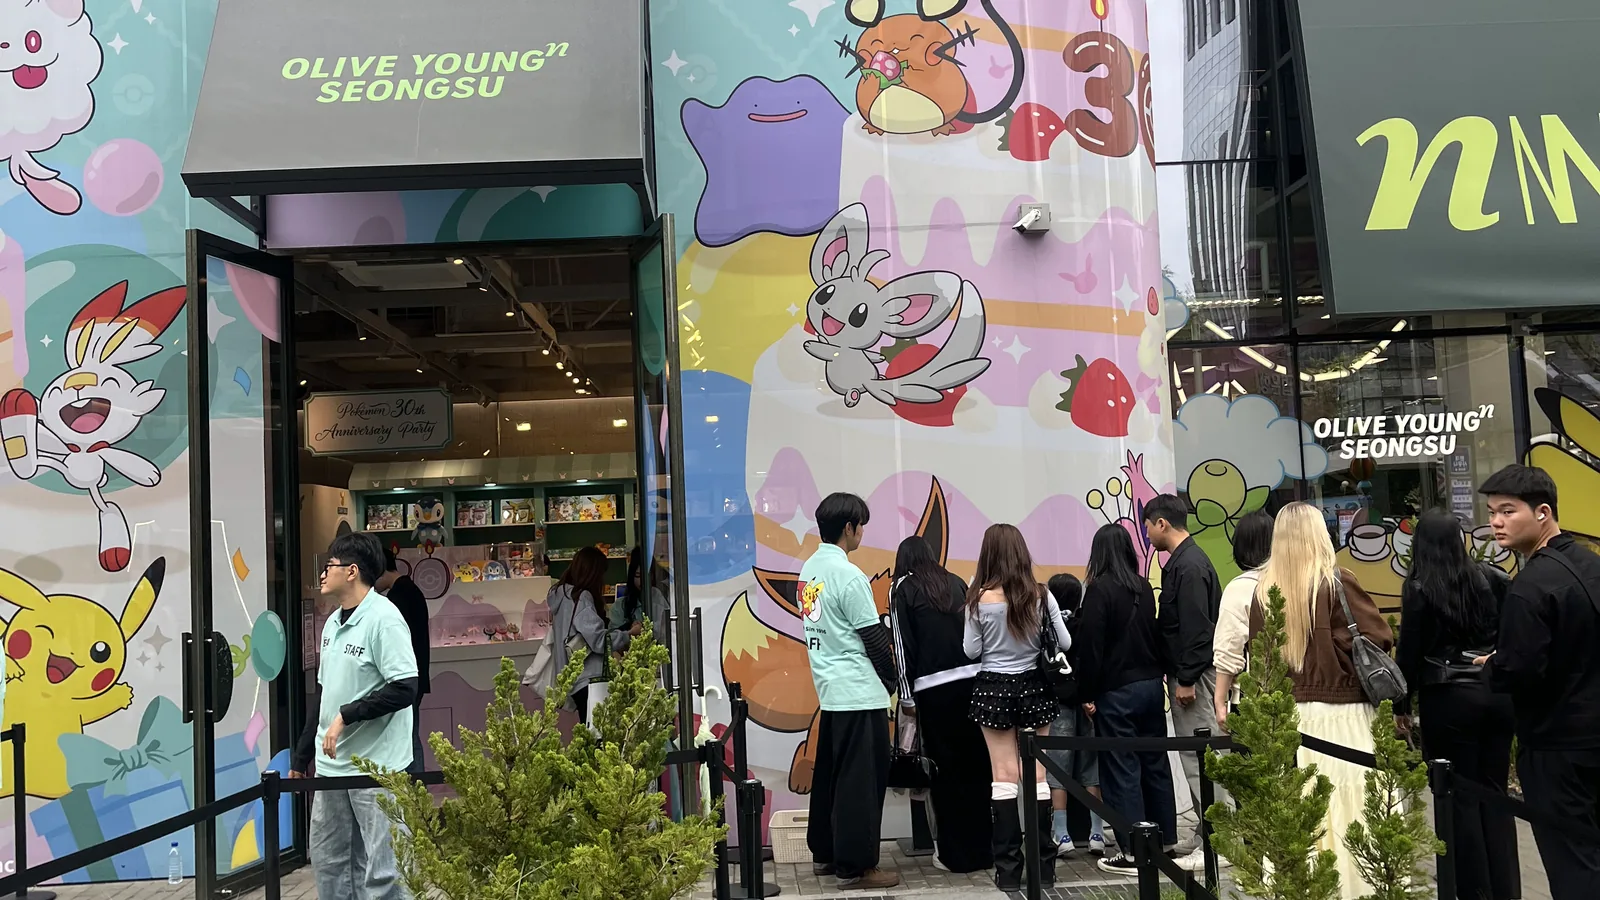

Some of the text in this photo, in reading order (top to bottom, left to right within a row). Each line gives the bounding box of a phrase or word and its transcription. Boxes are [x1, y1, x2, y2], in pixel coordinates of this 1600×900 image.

[281, 55, 398, 80] OLIVE
[316, 76, 505, 103] SEONGSU
[390, 399, 427, 418] 30th
[314, 420, 438, 444] Anniversary Party
[1313, 415, 1386, 439] OLIVE
[1339, 434, 1457, 460] SEONGSU
[344, 643, 365, 657] STAFF
